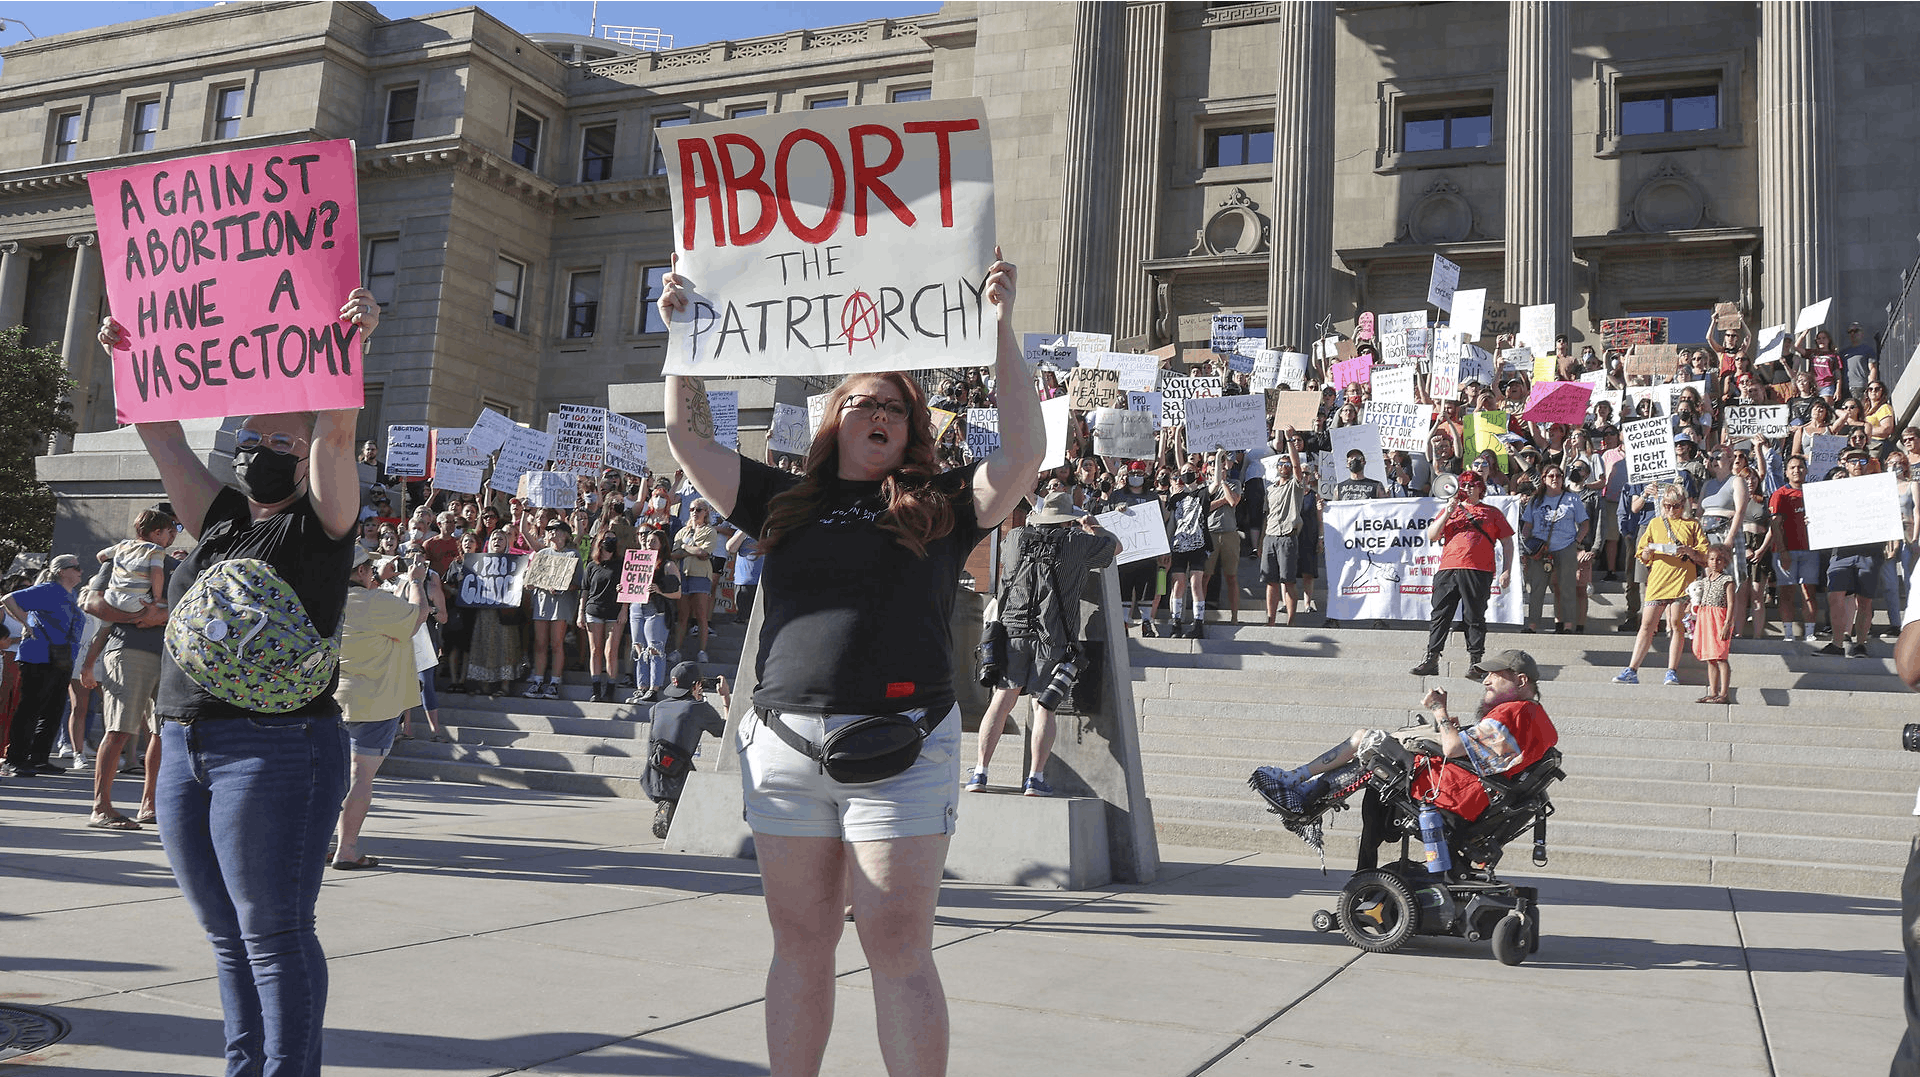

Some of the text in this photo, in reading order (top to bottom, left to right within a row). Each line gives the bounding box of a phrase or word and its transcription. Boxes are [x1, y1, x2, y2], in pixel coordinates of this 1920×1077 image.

[677, 119, 980, 250] ABORT
[120, 154, 320, 230] AGAINST
[126, 200, 340, 281] ABORTION?
[765, 245, 845, 285] THE
[138, 269, 300, 338] HAVE A
[688, 272, 992, 361] PATRIARCHY
[1212, 316, 1232, 324] UNITE
[1402, 314, 1424, 325] BODY
[1437, 329, 1442, 341] I
[1435, 341, 1449, 352] AM
[131, 322, 360, 402] VASECTOMY
[1071, 368, 1120, 381] ABORTION
[1444, 366, 1455, 376] MY
[1162, 378, 1223, 390] you can
[1433, 376, 1455, 397] BODY
[1072, 387, 1116, 399] HEALTH
[1162, 387, 1196, 400] only
[1076, 397, 1110, 408] CARE
[1132, 395, 1146, 405] PRO
[560, 404, 575, 412] MEN
[1366, 402, 1418, 415] RESPECT OUR
[1729, 407, 1781, 419] ABORT
[559, 412, 570, 420] OF
[571, 414, 592, 423] 100%
[1365, 413, 1418, 429] EXISTENCE
[1624, 417, 1669, 433] WE WON'T
[1727, 423, 1790, 435] SUPREME COURT
[1398, 427, 1413, 438] OUR
[1628, 427, 1668, 441] GO BACK
[557, 436, 601, 446] WHERE ARE
[968, 433, 999, 446] BODILY
[1630, 436, 1667, 449] WE WILL
[557, 443, 571, 451] THE
[555, 450, 570, 458] FOR
[1633, 450, 1666, 463] FIGHT
[1634, 459, 1668, 473] BACK!
[1355, 518, 1402, 531] LEGAL
[1344, 536, 1386, 550] ONCE
[1390, 535, 1424, 548] AND
[628, 550, 653, 561] THINK
[1415, 555, 1426, 565] WE
[624, 560, 653, 572] OUTSIDE
[1409, 567, 1419, 576] WE
[626, 571, 652, 584] OF MY
[627, 583, 646, 595] BOX
